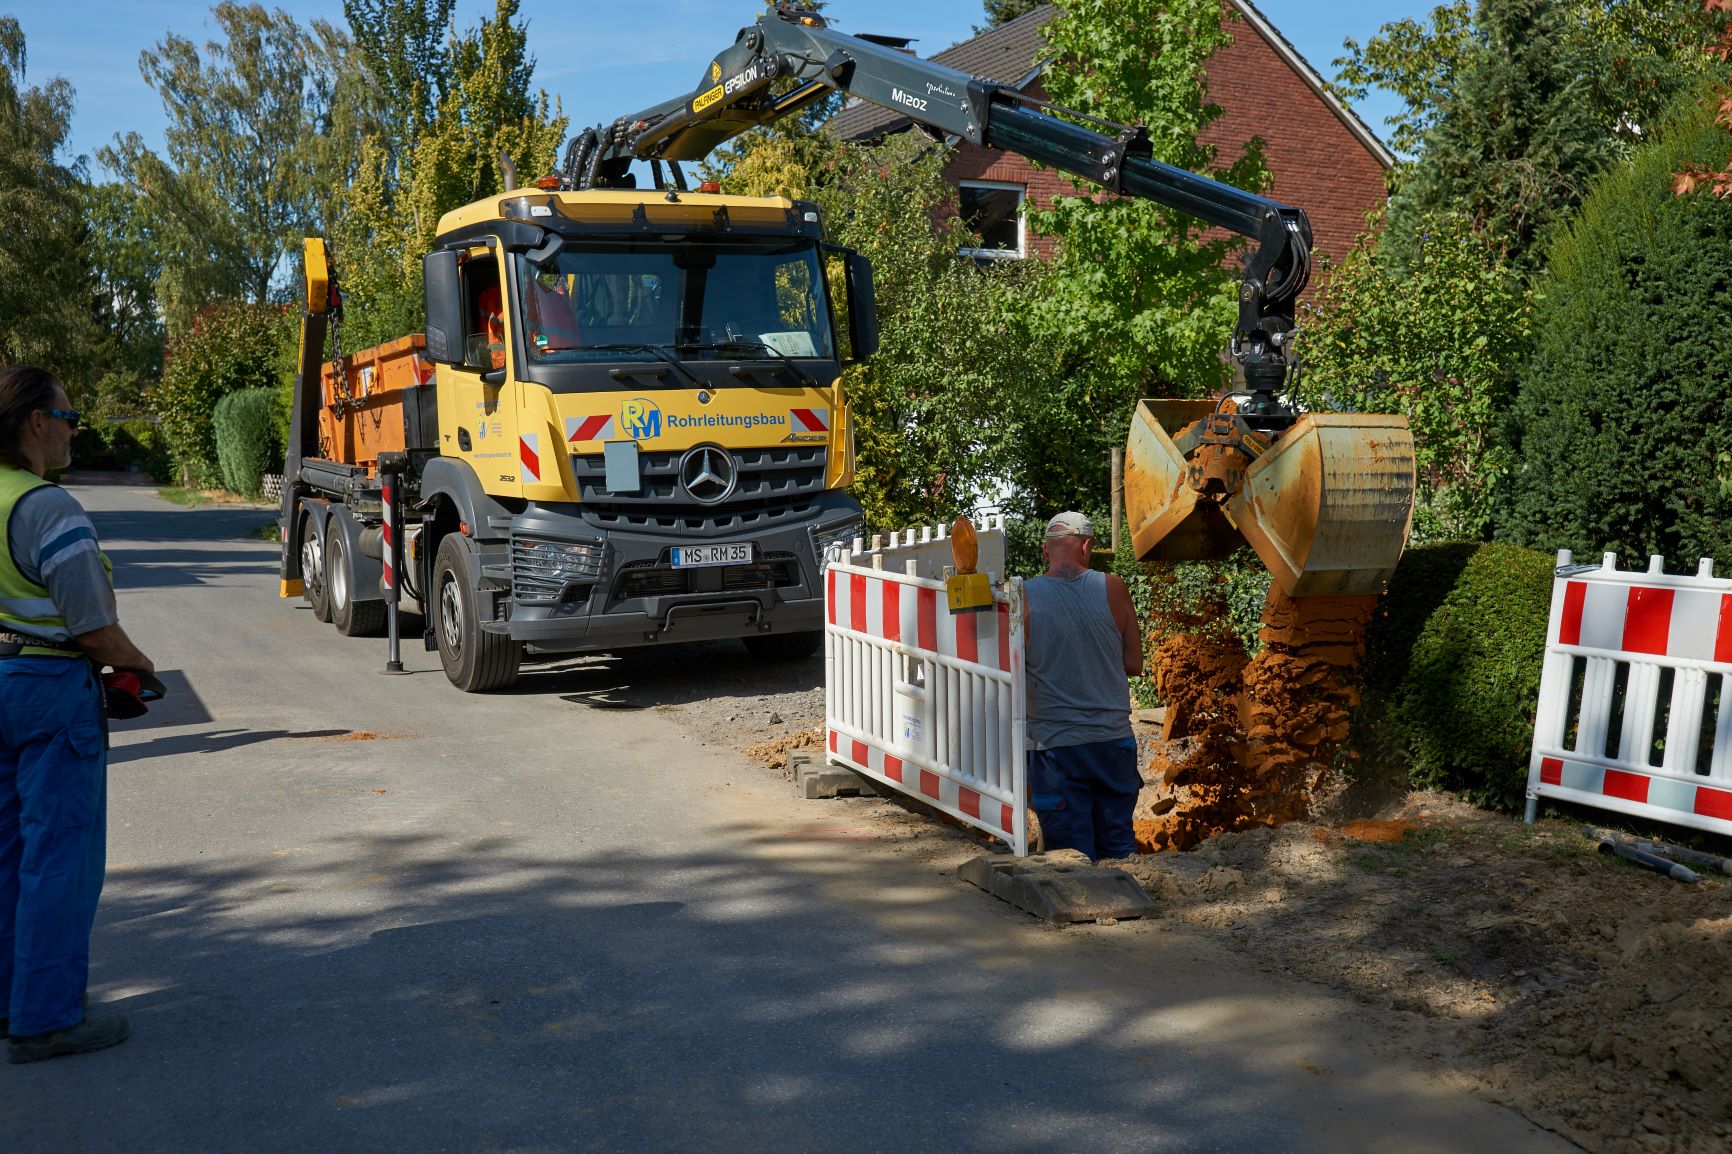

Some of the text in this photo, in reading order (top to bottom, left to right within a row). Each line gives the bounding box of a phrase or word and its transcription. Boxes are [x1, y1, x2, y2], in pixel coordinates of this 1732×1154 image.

[695, 65, 758, 111] PALFINGER EPSILON
[891, 87, 928, 112] M120Z
[621, 399, 661, 438] RM
[667, 413, 786, 429] Rohrleitungsbau
[684, 545, 746, 563] MS RM 35
